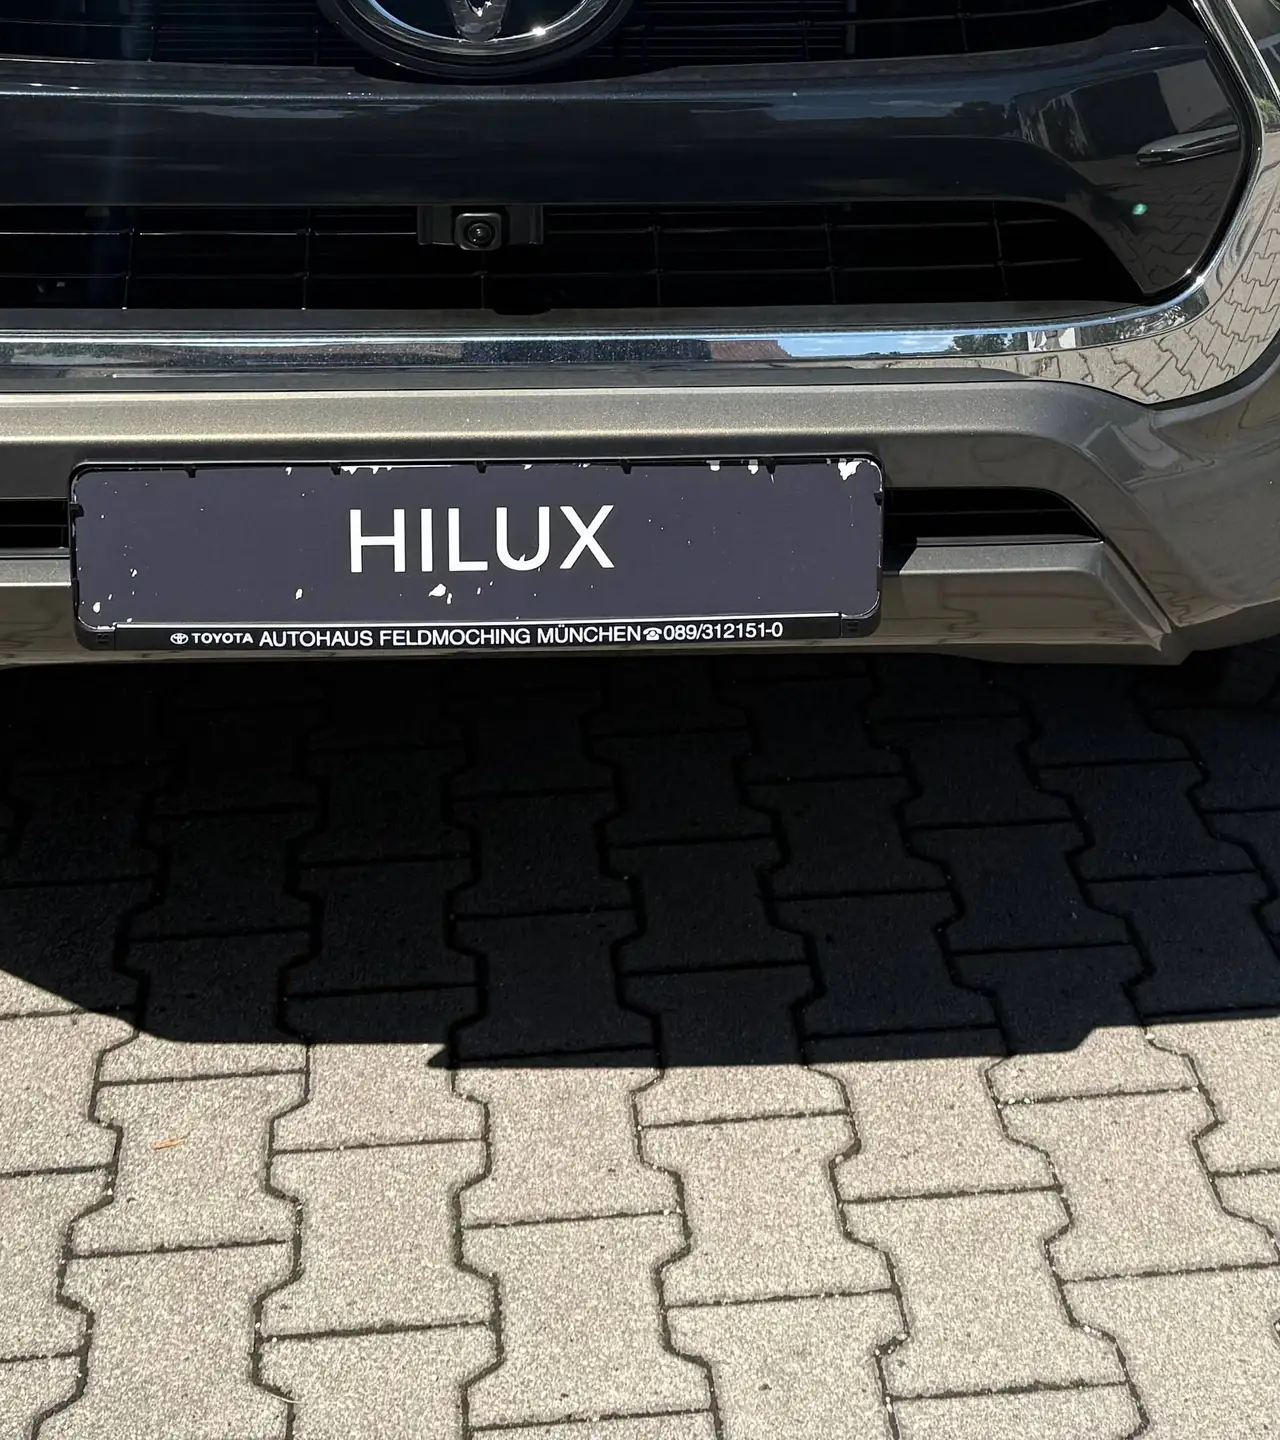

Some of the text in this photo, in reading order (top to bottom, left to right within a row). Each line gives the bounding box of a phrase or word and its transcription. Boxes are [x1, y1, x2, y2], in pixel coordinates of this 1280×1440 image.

[349, 504, 616, 574] HILUX
[191, 621, 784, 648] TOYOTA AUTOHAUS FELDMOCHING MÜNCHEN 089/312151-0
